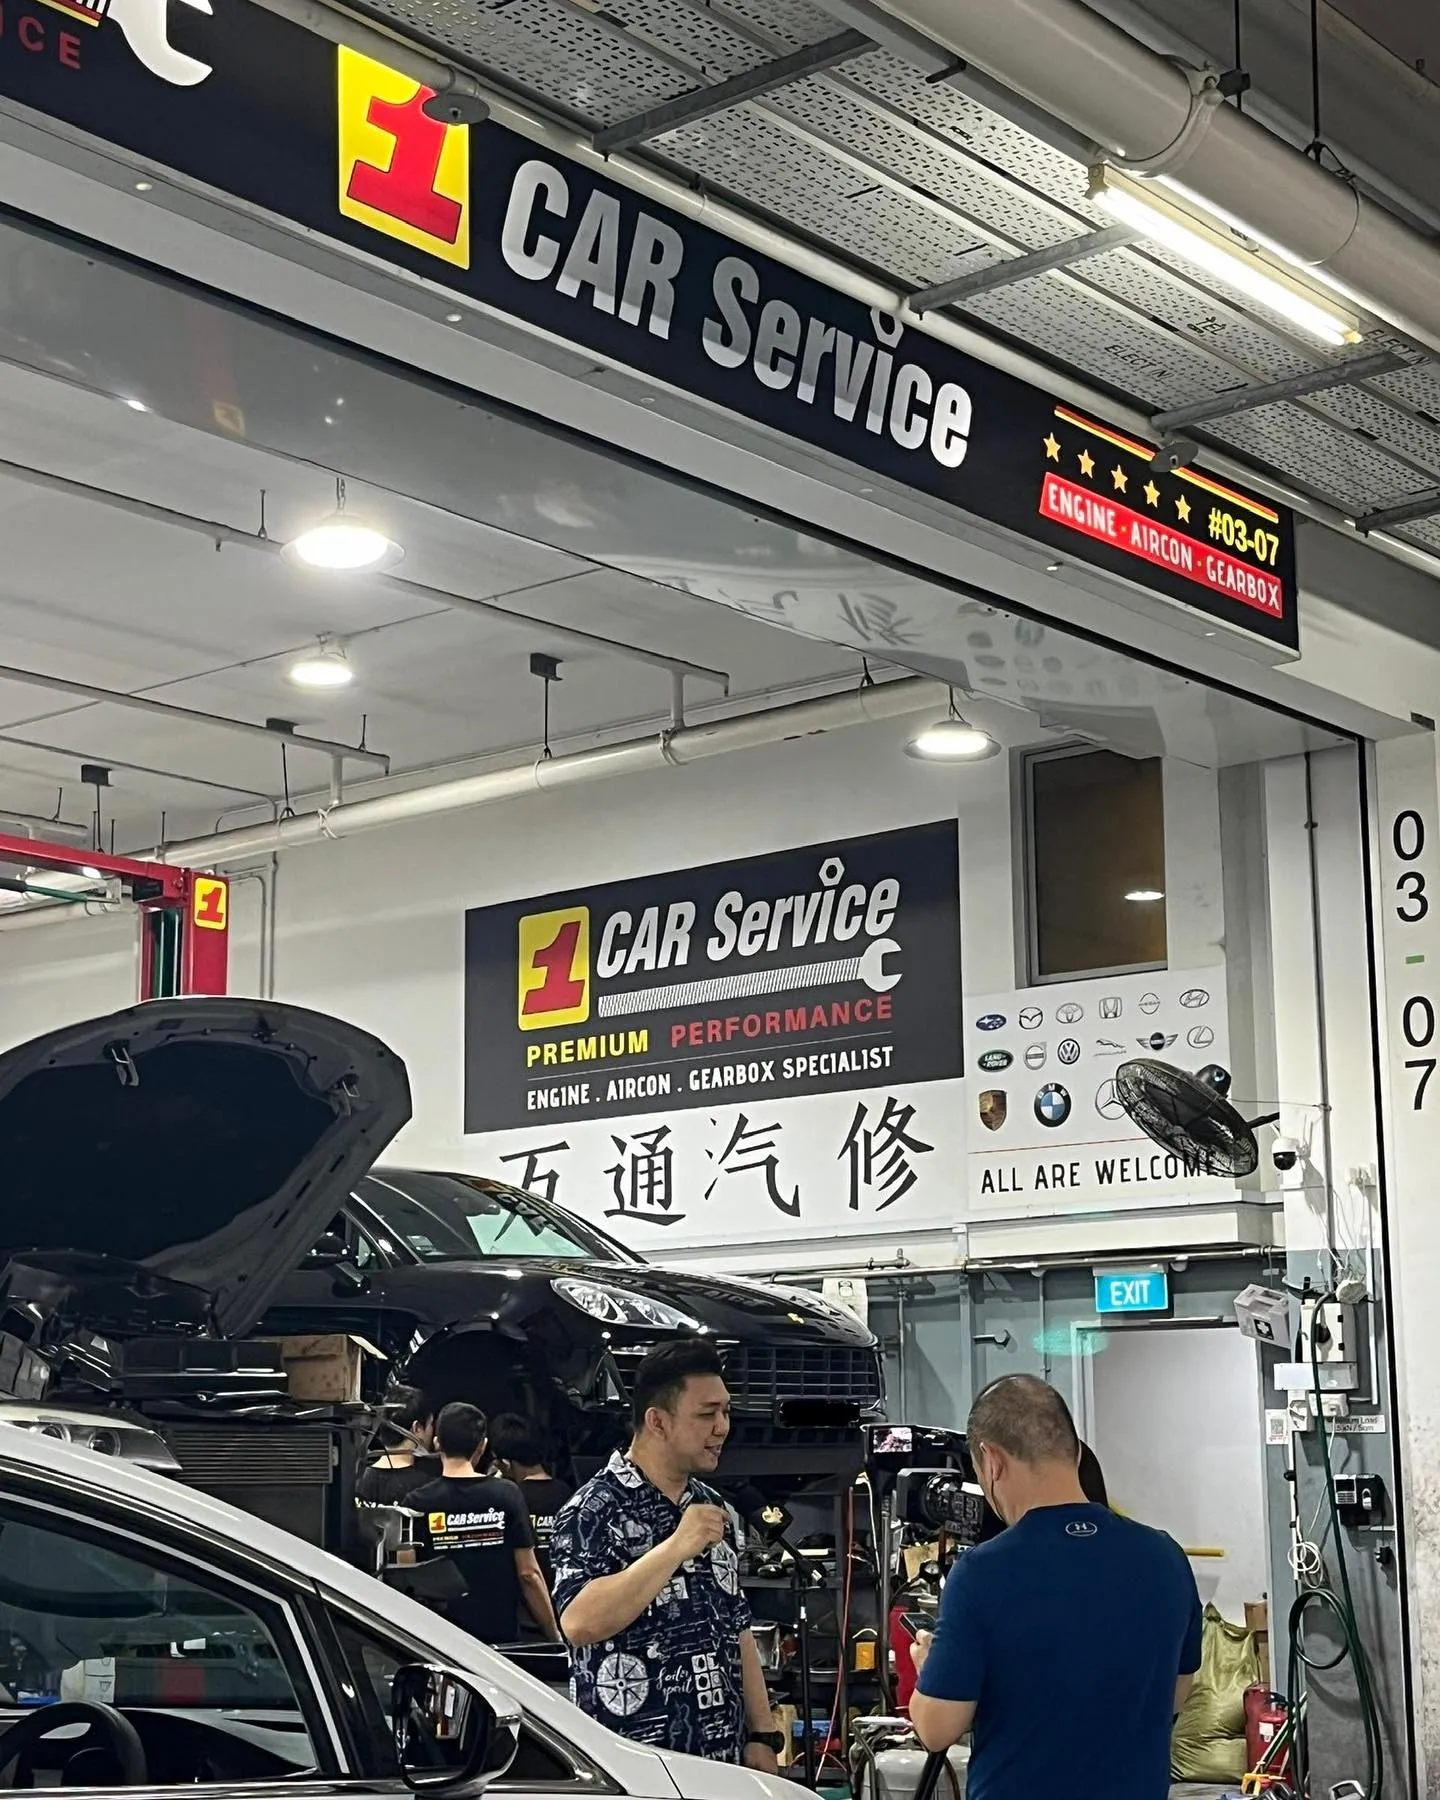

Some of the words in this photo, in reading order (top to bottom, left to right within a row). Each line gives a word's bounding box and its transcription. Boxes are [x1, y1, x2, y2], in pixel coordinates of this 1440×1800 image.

[0, 3, 81, 69] CE
[347, 85, 462, 244] 1
[502, 160, 684, 340] CAR
[703, 257, 973, 469] Service
[1104, 344, 1157, 372] ELECT
[1049, 482, 1117, 537] ENGINE
[1131, 521, 1194, 572] AIRCON
[1206, 555, 1280, 611] GEARBOX
[1208, 507, 1280, 567] #03-07
[196, 887, 224, 923] 1
[521, 920, 587, 1016] 1
[596, 901, 696, 979] CAR
[707, 860, 901, 962] Service
[526, 1029, 649, 1068] PREMIUM
[670, 995, 893, 1049] PERFORMANCE
[527, 1083, 590, 1111] ENGINE
[606, 1072, 671, 1102] AIRCON
[689, 1060, 775, 1092] GEARBOX
[783, 1046, 893, 1080] SPECIALIST
[981, 1167, 1023, 1194] ALL
[1034, 1162, 1080, 1190] ARE
[1110, 1280, 1150, 1306] EXIT
[430, 1515, 445, 1531] 1
[447, 1513, 467, 1526] CAR
[467, 1508, 505, 1525] Service
